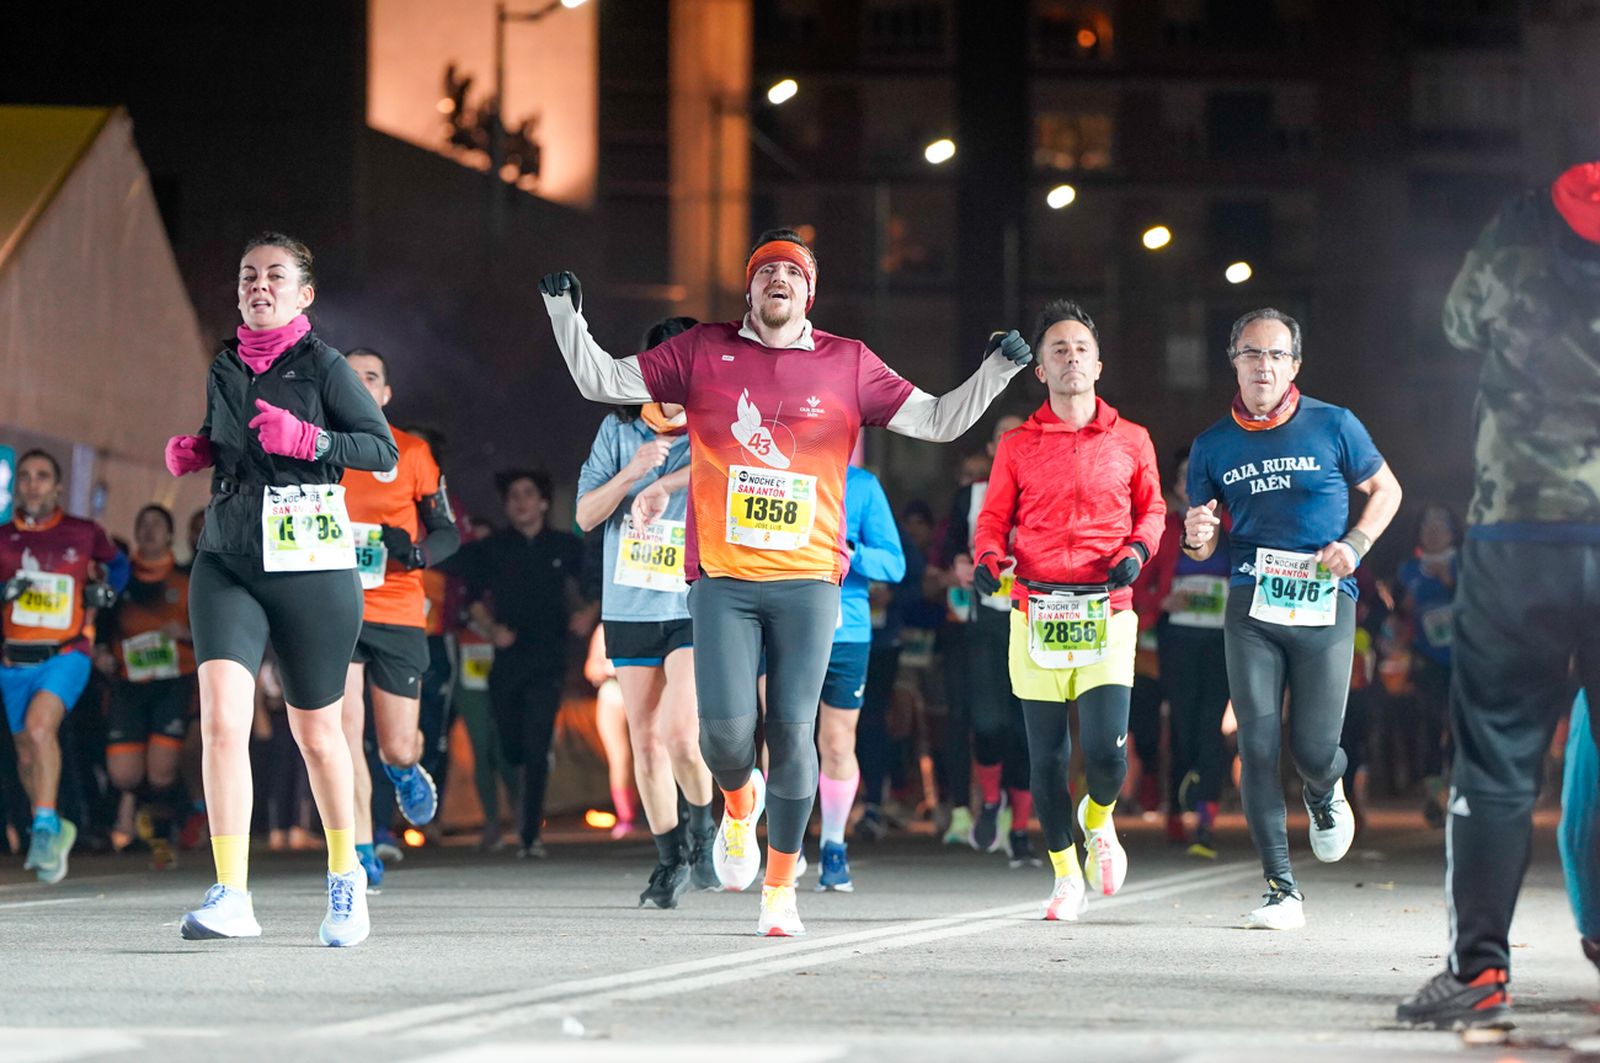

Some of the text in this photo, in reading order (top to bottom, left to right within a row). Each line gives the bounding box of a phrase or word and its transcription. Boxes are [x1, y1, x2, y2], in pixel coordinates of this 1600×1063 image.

[747, 433, 771, 456] 43
[1223, 456, 1321, 486] CAJA RURAL
[748, 476, 775, 487] NOCHE
[1249, 474, 1291, 495] JAÉN
[737, 484, 756, 495] SAN
[272, 506, 291, 515] SAN
[744, 496, 798, 525] 1358
[1264, 566, 1281, 575] SAN
[1274, 560, 1298, 569] NOCHE
[1299, 562, 1310, 570] DE
[1271, 577, 1321, 602] 9476
[1046, 602, 1069, 611] NOCHE
[1038, 612, 1053, 620] SAN
[1043, 621, 1097, 643] 2856
